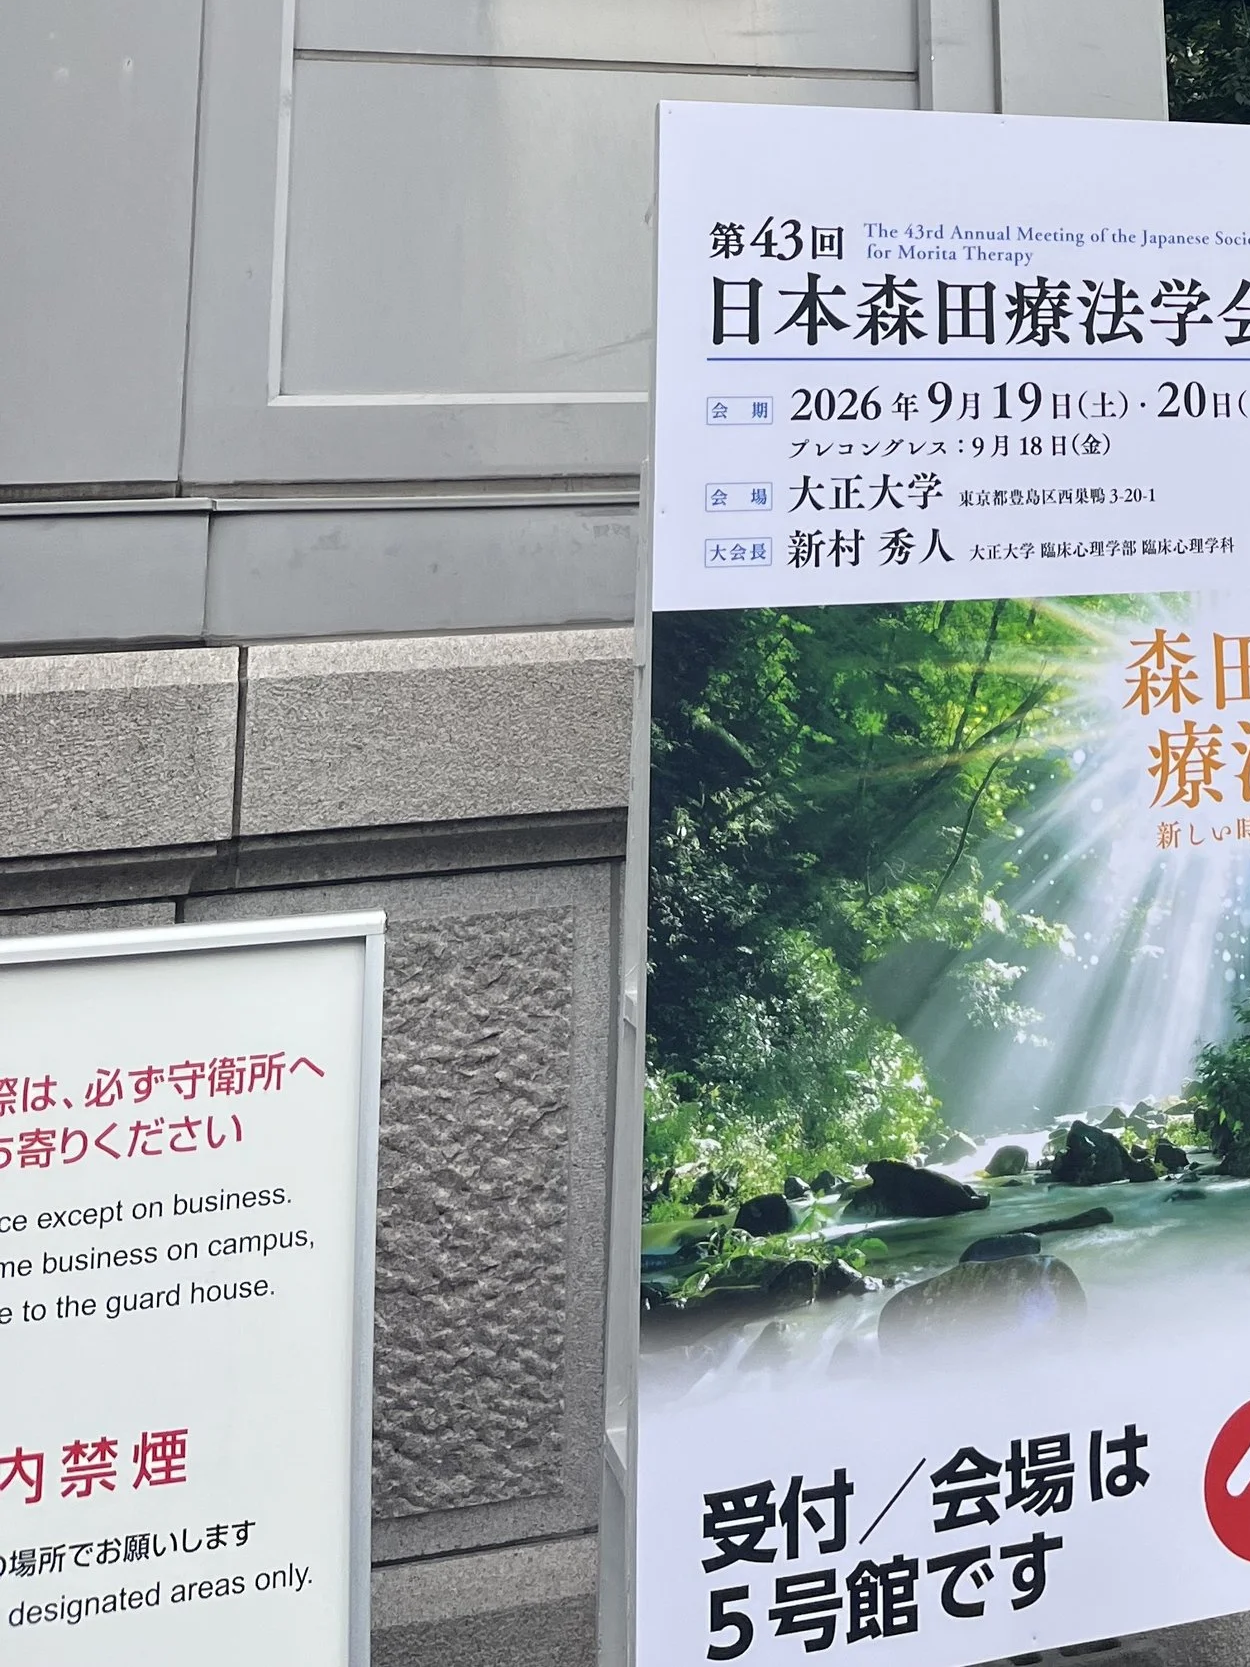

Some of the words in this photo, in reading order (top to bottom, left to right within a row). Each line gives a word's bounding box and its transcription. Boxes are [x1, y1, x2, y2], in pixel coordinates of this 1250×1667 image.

[709, 215, 845, 261] 第43回
[863, 222, 898, 239] The
[904, 223, 944, 240] 43rd
[950, 225, 1011, 241] Annual
[1017, 226, 1085, 248] Meeting
[1090, 227, 1109, 243] of
[1111, 228, 1137, 244] the
[1140, 229, 1210, 249] Japanese
[867, 243, 892, 259] for
[898, 244, 957, 261] Morita
[963, 246, 1033, 266] Therapy
[788, 471, 943, 513] 大正大学
[959, 487, 1106, 508] 東京都豊島区西巣鴨
[1109, 488, 1155, 504] 3-20-1
[710, 542, 767, 562] 大会長
[787, 528, 866, 569] 新村
[878, 527, 955, 566] 秀人
[970, 542, 1035, 561] 大正大学
[1040, 539, 1137, 559] 臨床心理学部
[1141, 536, 1235, 556] 臨床心理学科
[37, 1200, 123, 1230] except
[132, 1201, 163, 1220] on
[173, 1187, 292, 1216] business.
[42, 1246, 158, 1275] business
[167, 1242, 198, 1261] on
[208, 1229, 314, 1257] campus,
[22, 1300, 47, 1323] to
[55, 1295, 97, 1319] the
[106, 1283, 181, 1320] guard
[190, 1279, 275, 1305] house.
[0, 1520, 256, 1578] 場所でお願いします
[8, 1581, 161, 1627] designated
[170, 1575, 246, 1604] areas
[254, 1562, 313, 1593] only.
[705, 1531, 1063, 1661] 5号館です
